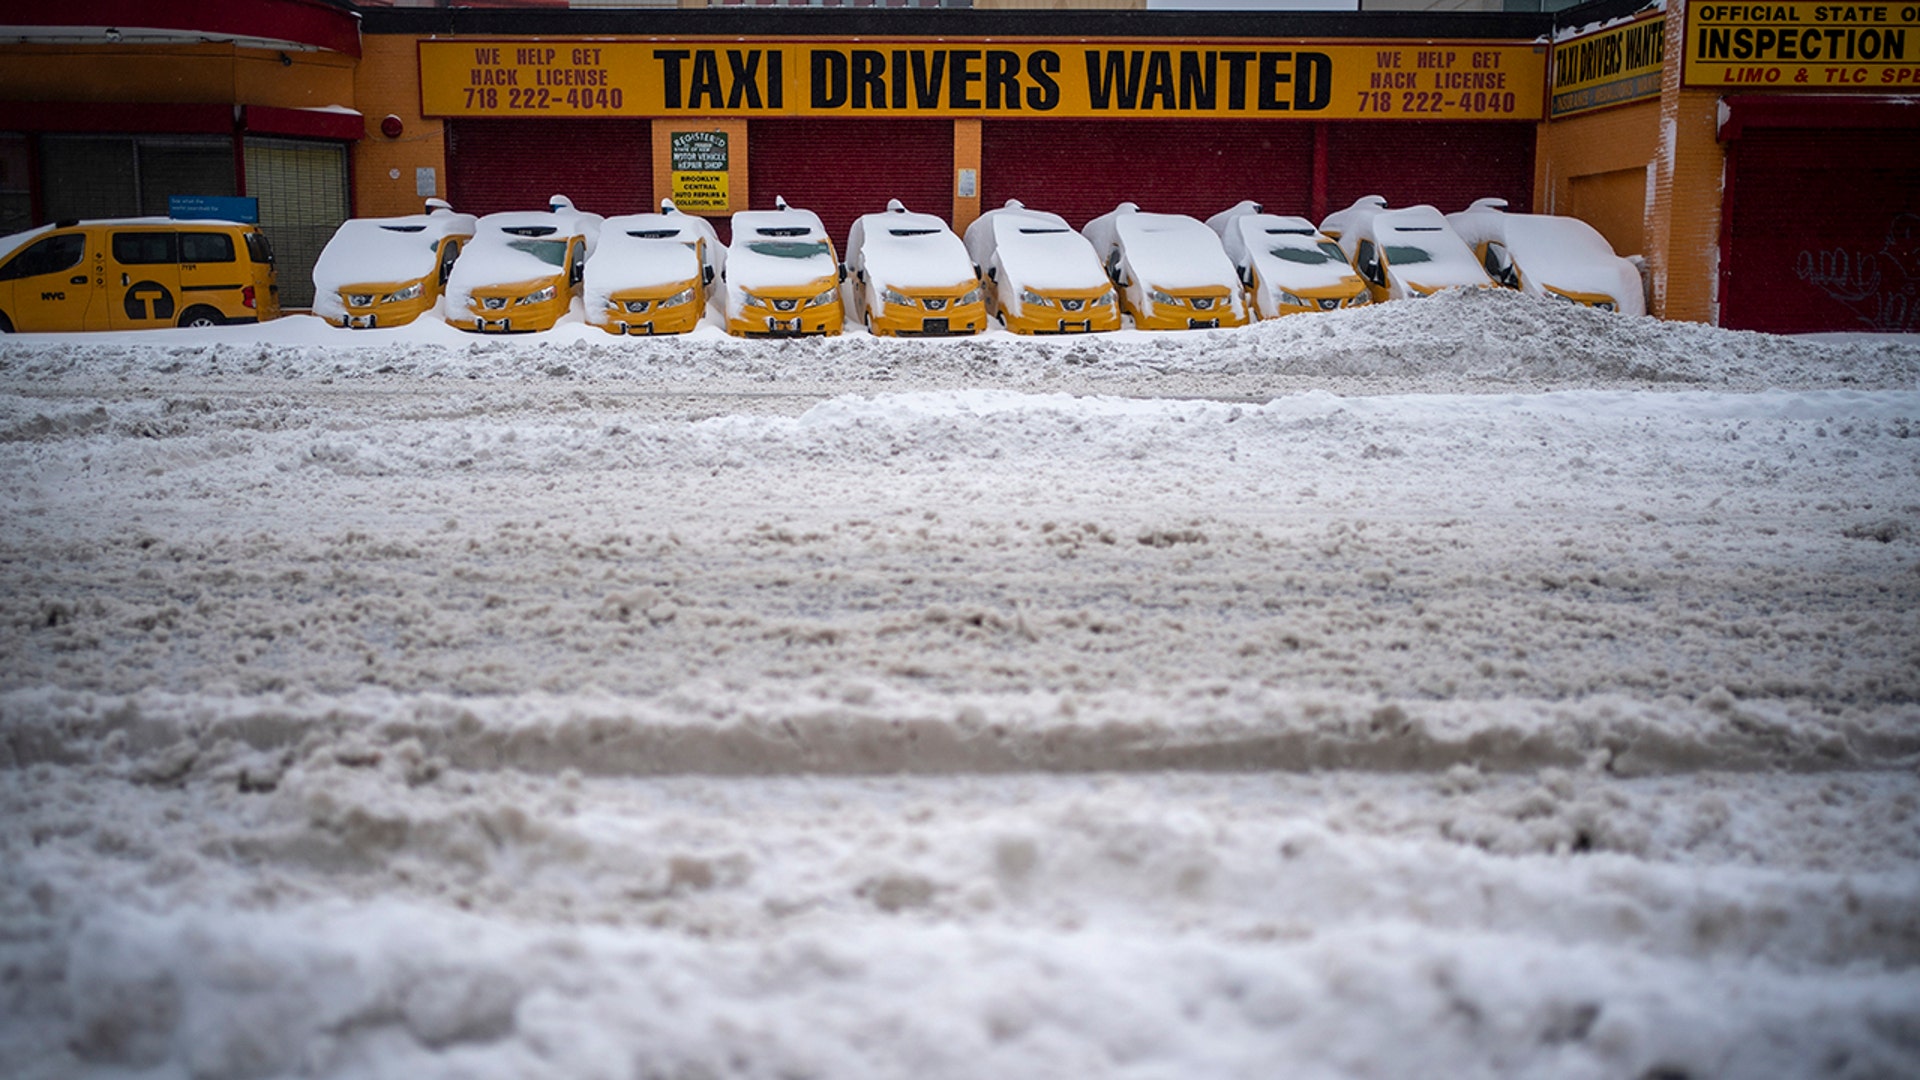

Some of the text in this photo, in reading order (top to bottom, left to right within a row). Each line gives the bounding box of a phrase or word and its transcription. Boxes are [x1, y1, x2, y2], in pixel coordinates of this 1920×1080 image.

[1699, 5, 1920, 22] OFFICIAL STATE O
[1697, 28, 1905, 60] INSPECTION
[475, 48, 602, 65] WE HELP GET
[1377, 51, 1502, 69] WE HELP GET
[1556, 46, 1578, 88] TAXI
[1579, 32, 1623, 82] DRIVERS
[471, 69, 608, 86] HACK LICENSE
[653, 49, 1332, 111] TAXI DRIVERS WANTED
[1370, 72, 1506, 89] HACK LICENSE
[1723, 68, 1781, 83] LIMO
[1794, 68, 1809, 83] &
[1825, 68, 1868, 83] TLC
[463, 88, 623, 109] 718 222-4040
[1358, 92, 1516, 112] 718 222-4040
[704, 161, 724, 169] SHOP
[41, 292, 65, 300] NYC
